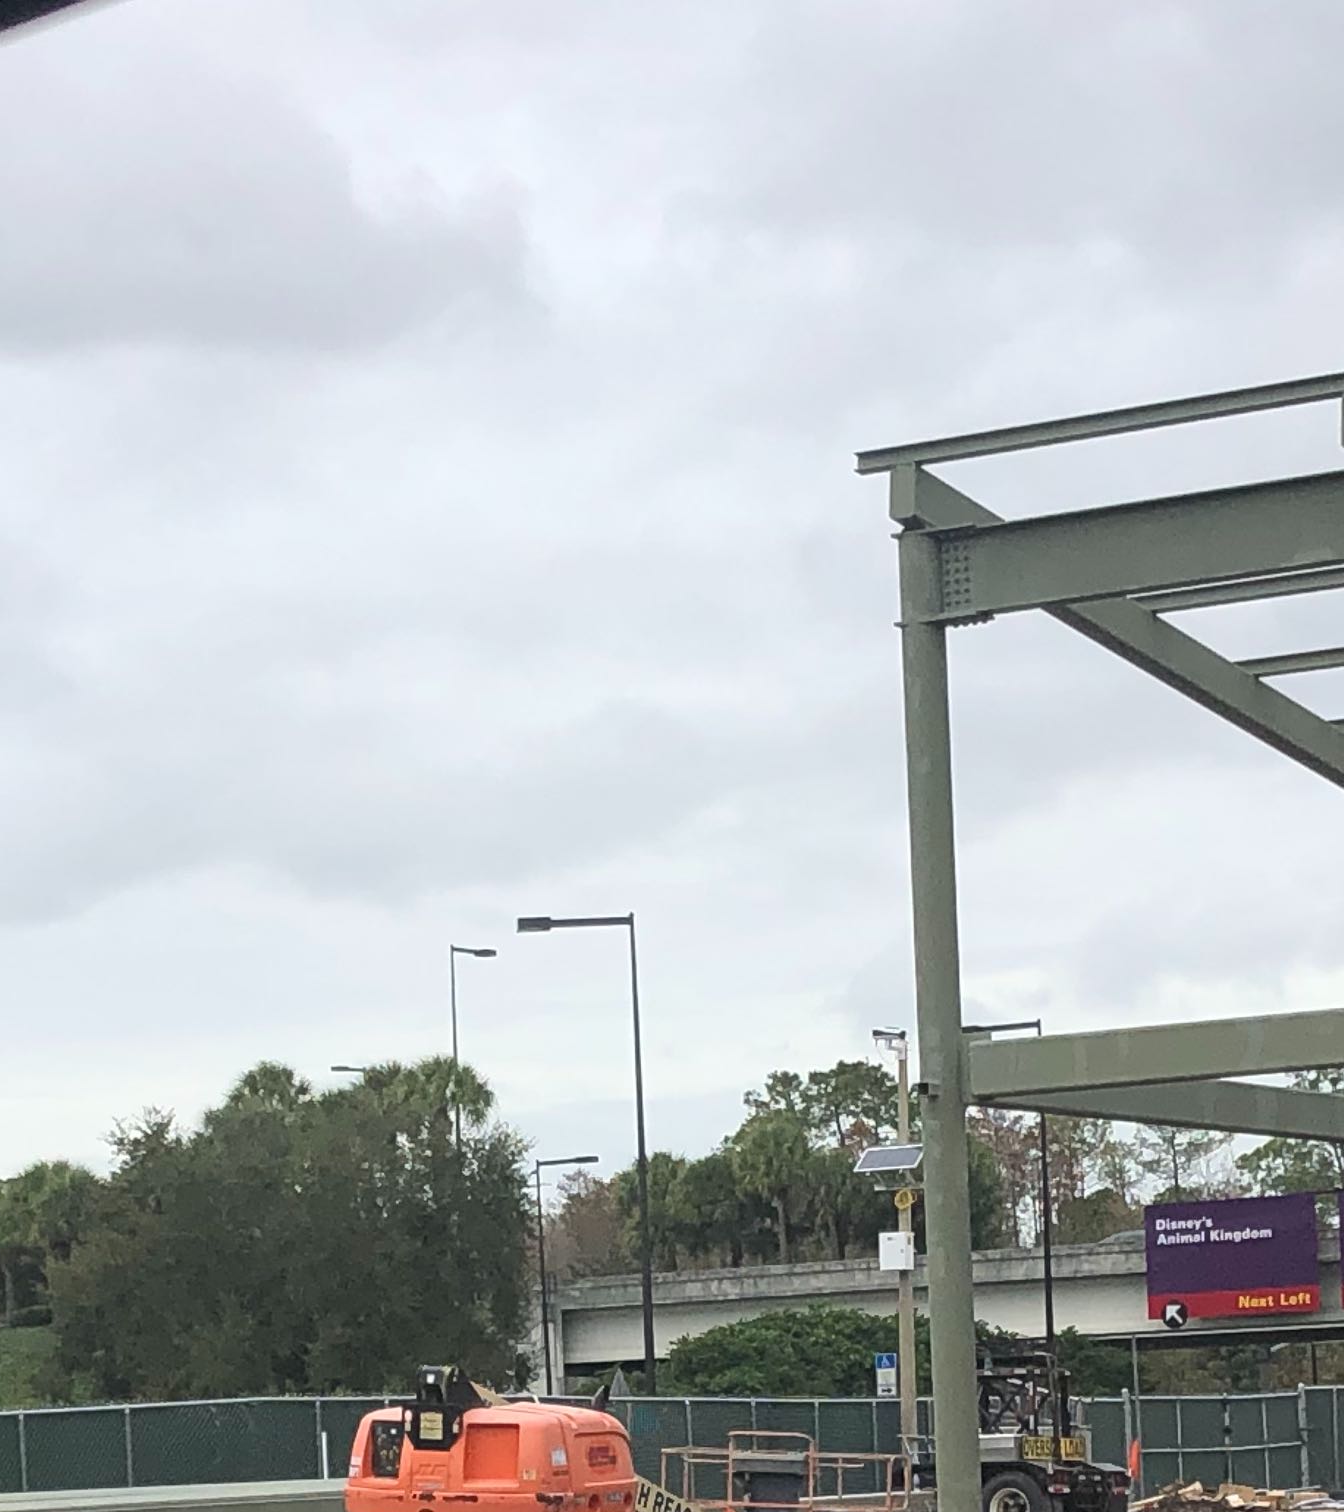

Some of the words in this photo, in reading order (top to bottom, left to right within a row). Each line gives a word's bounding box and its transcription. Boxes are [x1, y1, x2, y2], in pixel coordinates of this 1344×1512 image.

[1155, 1216, 1213, 1230] Disney's
[1157, 1231, 1205, 1245] Animal
[1210, 1227, 1273, 1242] Kingdom
[1238, 1295, 1274, 1308] Next
[1280, 1292, 1311, 1306] Left
